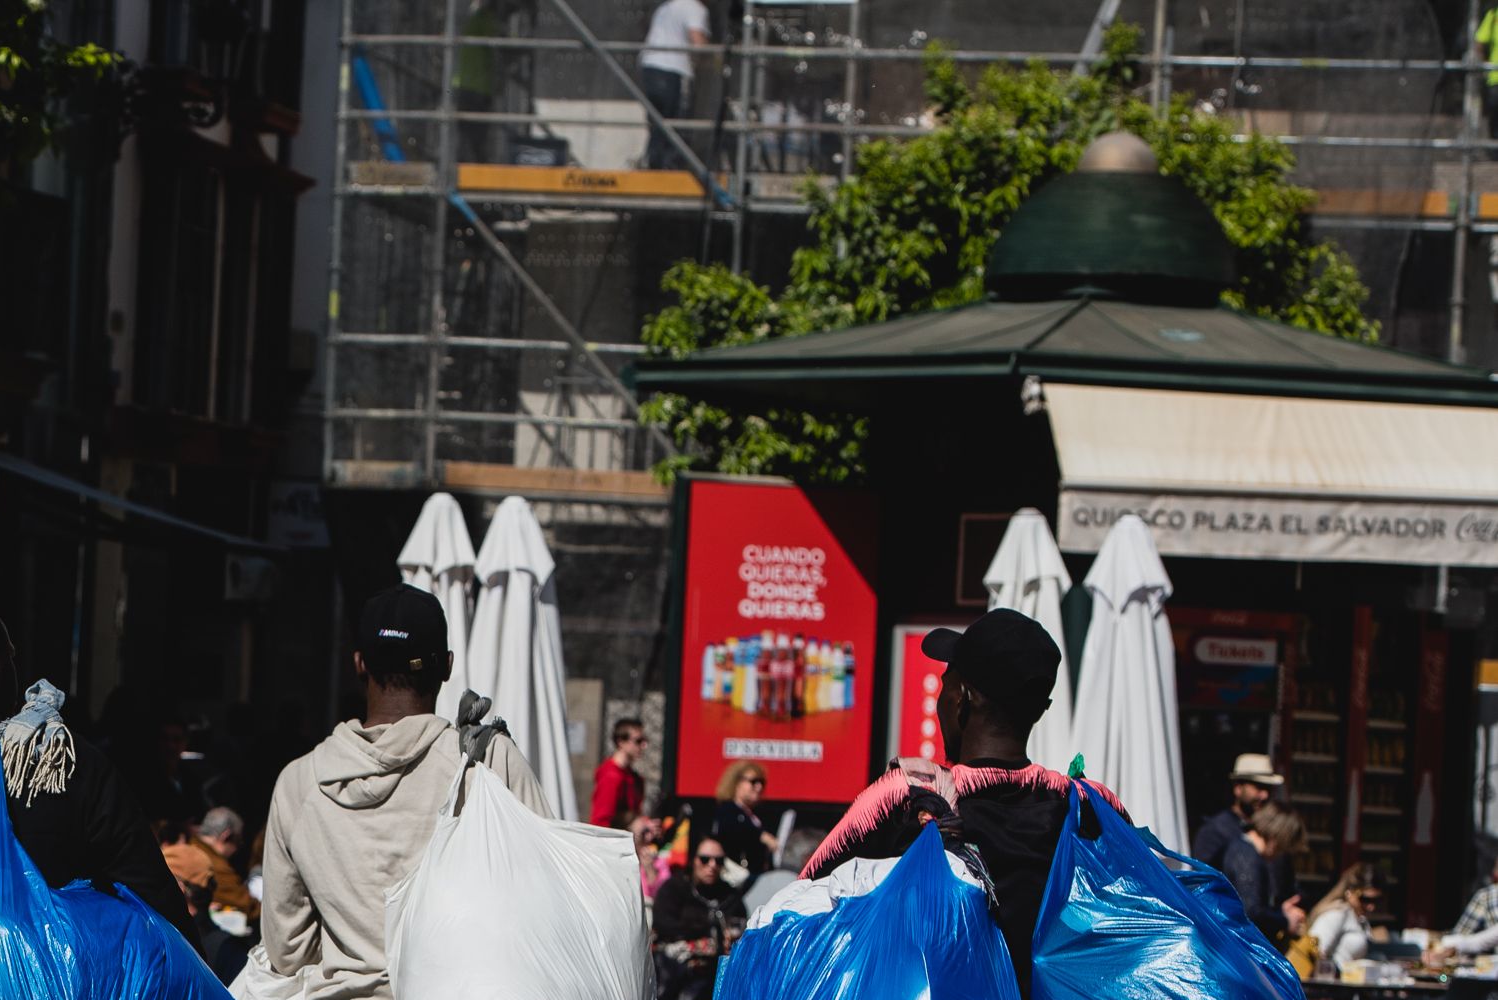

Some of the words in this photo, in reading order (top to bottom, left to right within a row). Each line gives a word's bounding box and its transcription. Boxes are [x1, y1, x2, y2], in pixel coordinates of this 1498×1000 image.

[1193, 512, 1272, 533] PLAZA
[1281, 515, 1309, 534] EL
[1316, 516, 1445, 538] SALVADOR
[742, 544, 826, 565] CUANDO
[747, 582, 818, 601] DONDE
[738, 599, 826, 621] QUIERAS
